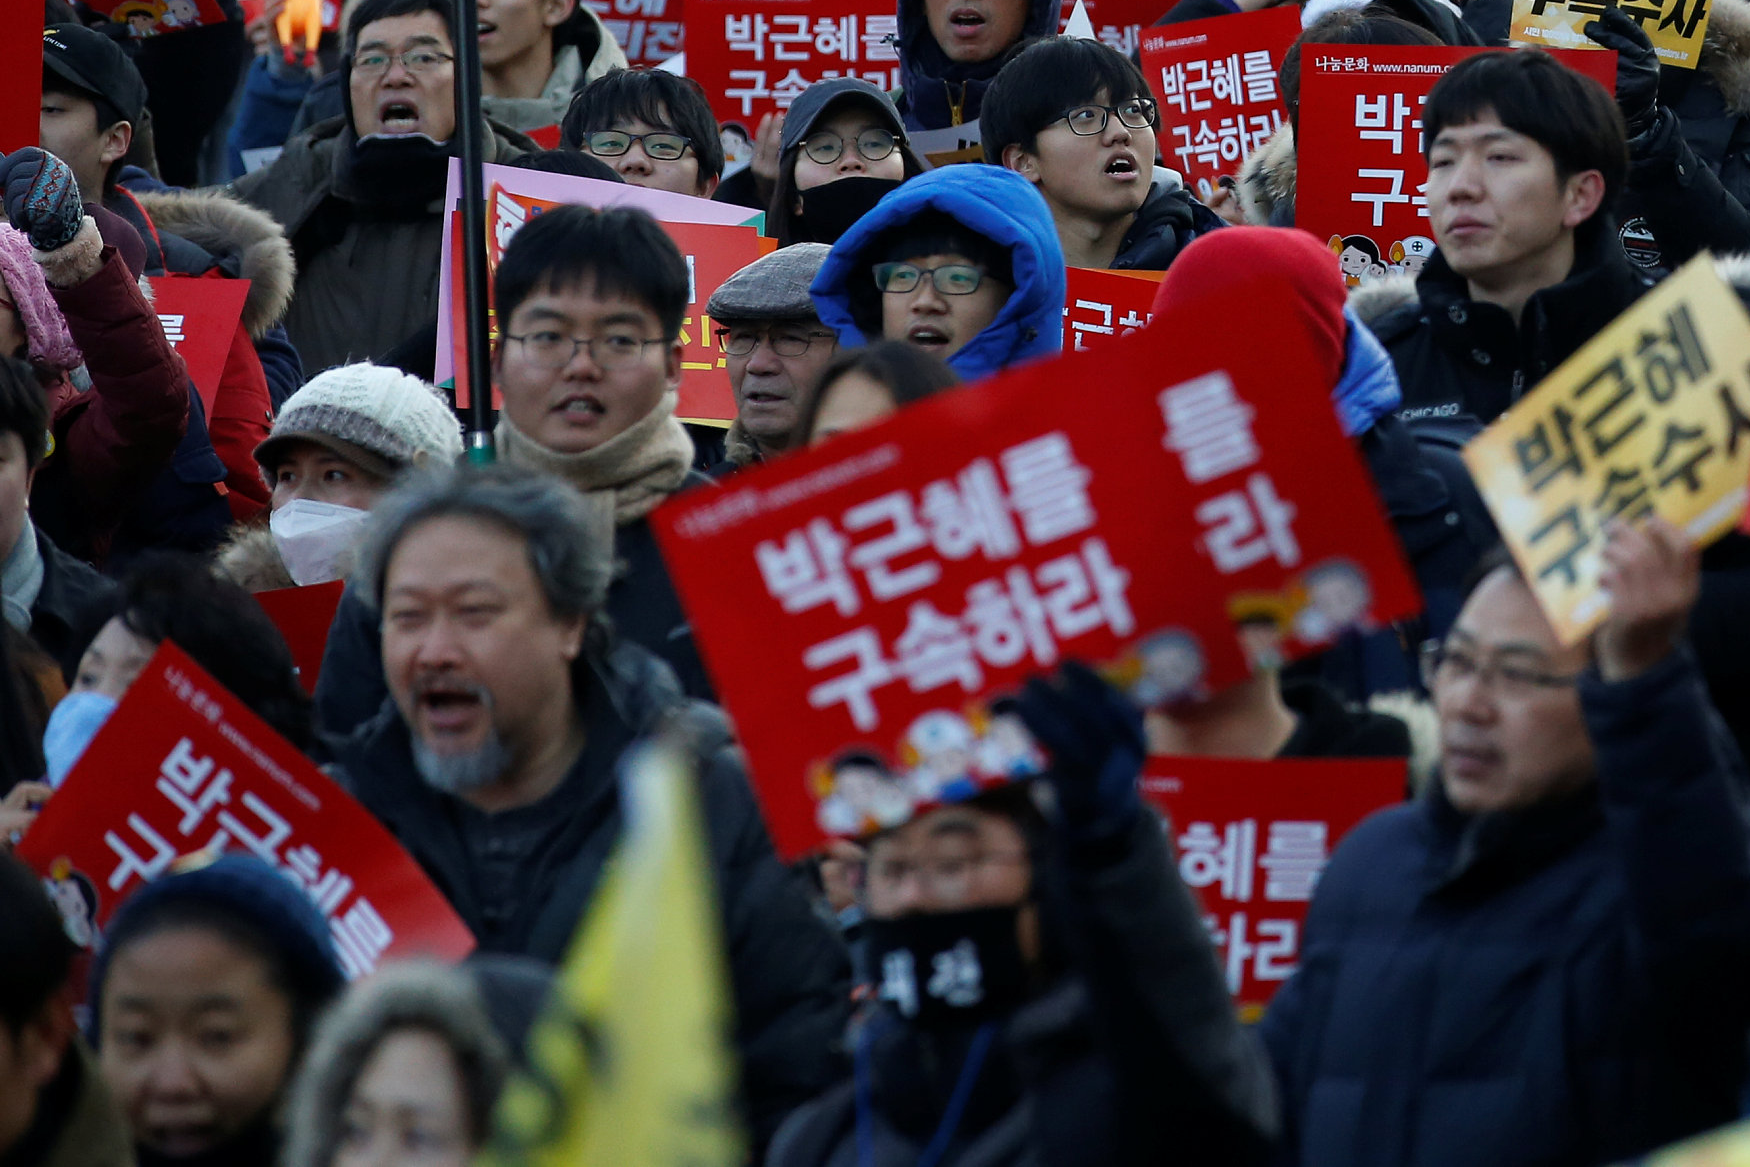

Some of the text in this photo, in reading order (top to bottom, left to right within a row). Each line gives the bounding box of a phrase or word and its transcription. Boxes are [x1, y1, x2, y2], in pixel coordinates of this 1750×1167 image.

[724, 12, 899, 63] 박근혜를
[1315, 55, 1370, 74] 나눔문화
[1161, 49, 1278, 114] 박근혜를
[1174, 109, 1282, 174] 구속하라
[1354, 91, 1428, 156] 박
[1351, 167, 1430, 227] 구
[1157, 368, 1262, 484] 를
[1400, 402, 1461, 422] CHICAGO
[1512, 301, 1711, 492] 박근혜
[753, 430, 1099, 617] 박근혜를
[1193, 471, 1303, 575] 라
[802, 535, 1137, 731] 구속하라
[155, 736, 395, 982] 박근혜를
